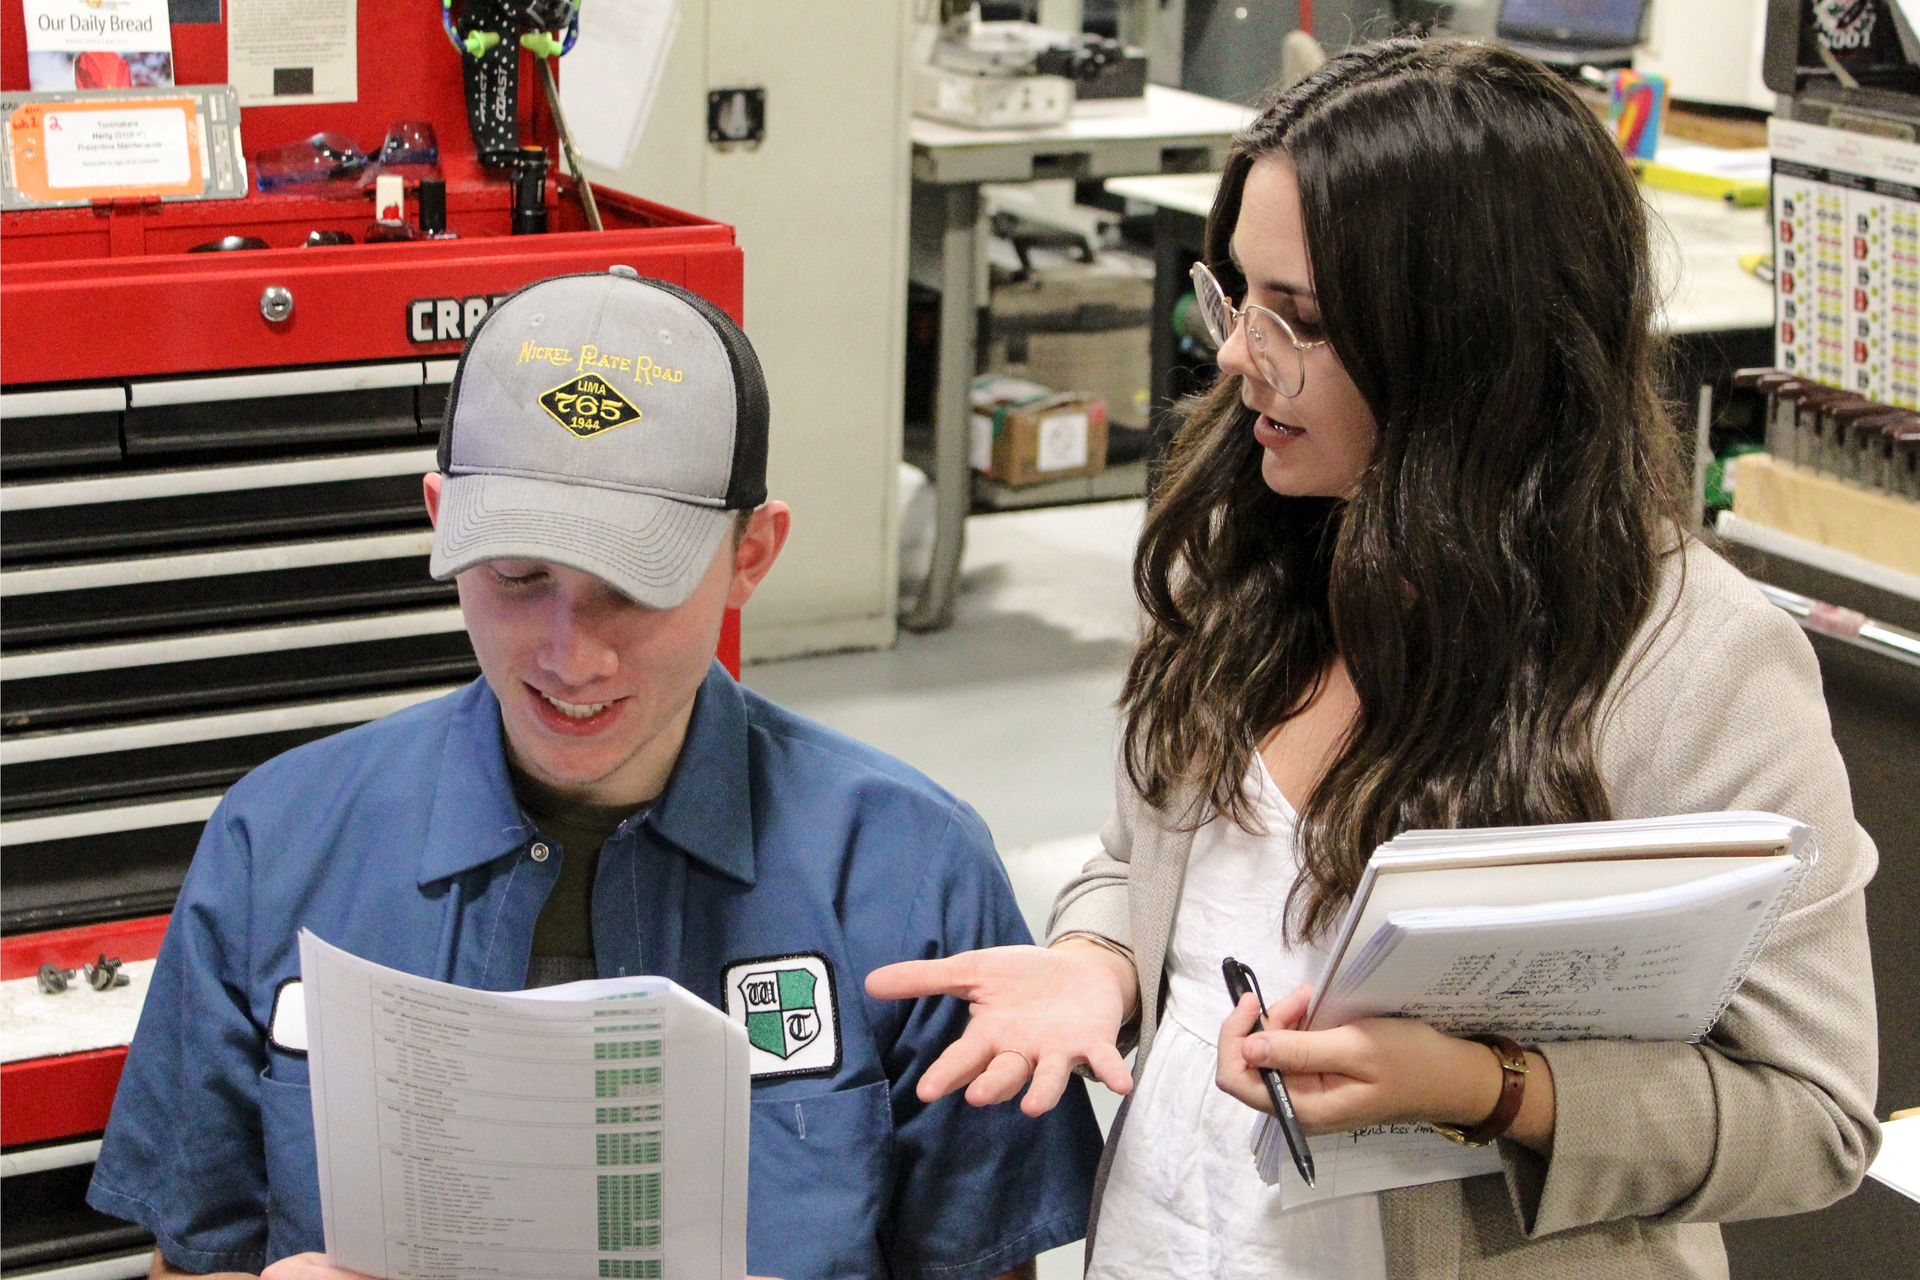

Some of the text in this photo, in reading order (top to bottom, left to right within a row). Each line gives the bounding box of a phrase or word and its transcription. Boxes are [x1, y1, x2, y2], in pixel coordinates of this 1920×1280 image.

[38, 14, 153, 36] Our Daily Bread
[496, 65, 508, 122] COAST
[49, 115, 62, 132] 2
[78, 141, 162, 152] Preventive Maintenance
[408, 296, 506, 342] CRA
[577, 380, 607, 396] LIMA
[555, 391, 624, 420] 765
[569, 416, 600, 432] 1944
[746, 980, 777, 1006] W
[786, 1012, 814, 1042] T
[1348, 1124, 1386, 1144] spend
[1390, 1124, 1410, 1134] less
